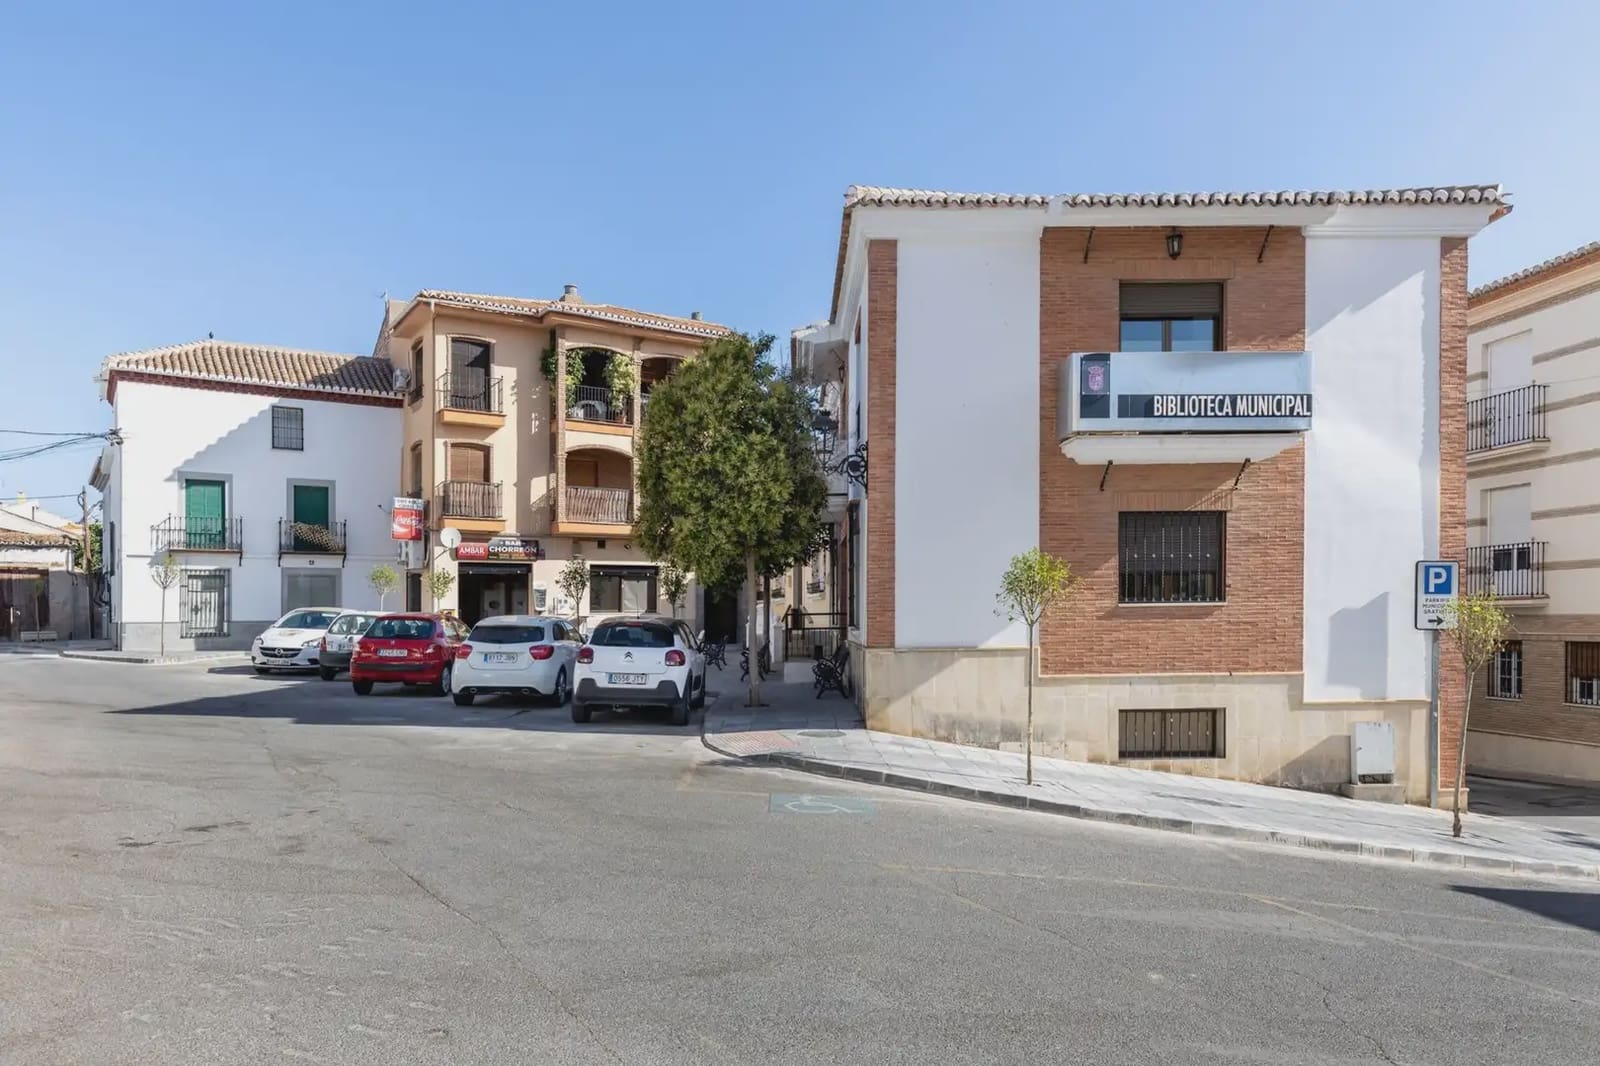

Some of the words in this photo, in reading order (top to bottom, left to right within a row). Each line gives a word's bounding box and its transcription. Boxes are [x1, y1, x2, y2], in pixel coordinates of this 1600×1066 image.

[1153, 395, 1232, 416] BIBLIOTECA
[1235, 395, 1311, 416] MUNICIPAL
[458, 546, 485, 554] AMBAR
[1428, 567, 1447, 592] P
